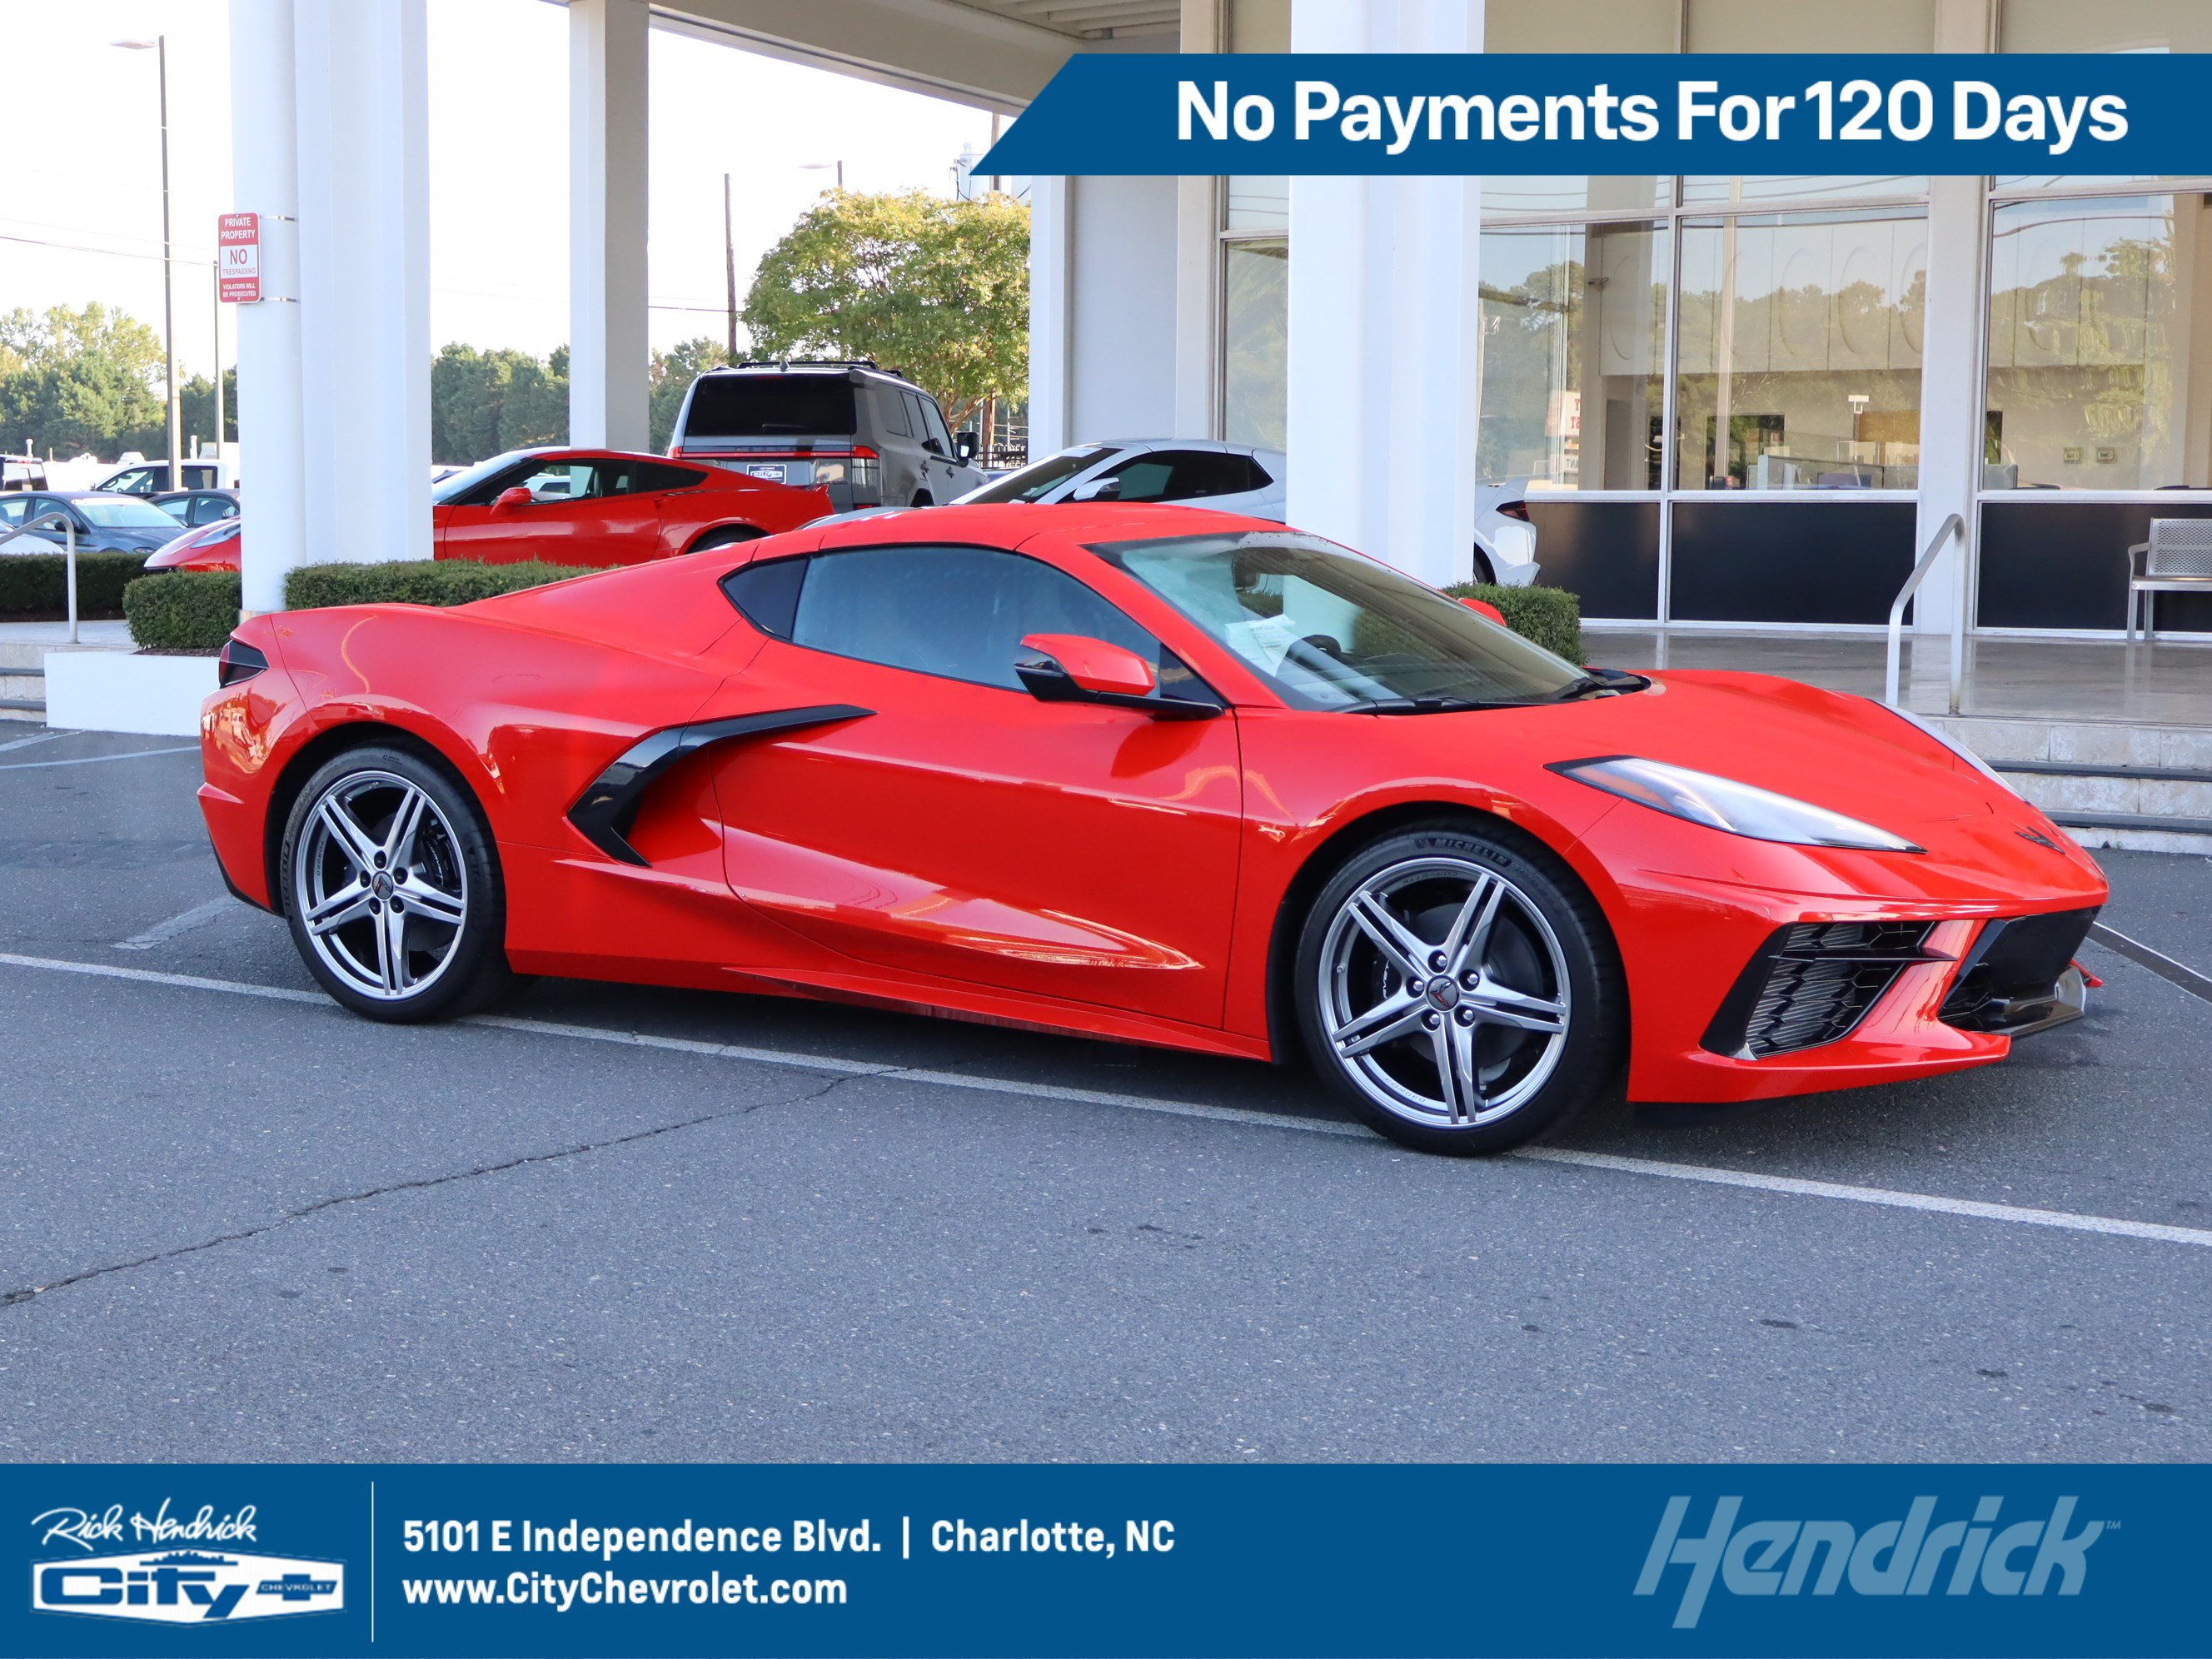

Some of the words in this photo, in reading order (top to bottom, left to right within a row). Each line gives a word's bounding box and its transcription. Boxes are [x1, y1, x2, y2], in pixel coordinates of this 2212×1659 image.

[224, 217, 252, 227] PRIVATE
[221, 230, 256, 240] PROPERTY
[230, 248, 247, 265] NO
[222, 267, 257, 276] TRESPASSING
[1434, 838, 1508, 867] MICHELIN
[1384, 1078, 1427, 1104] FORGED
